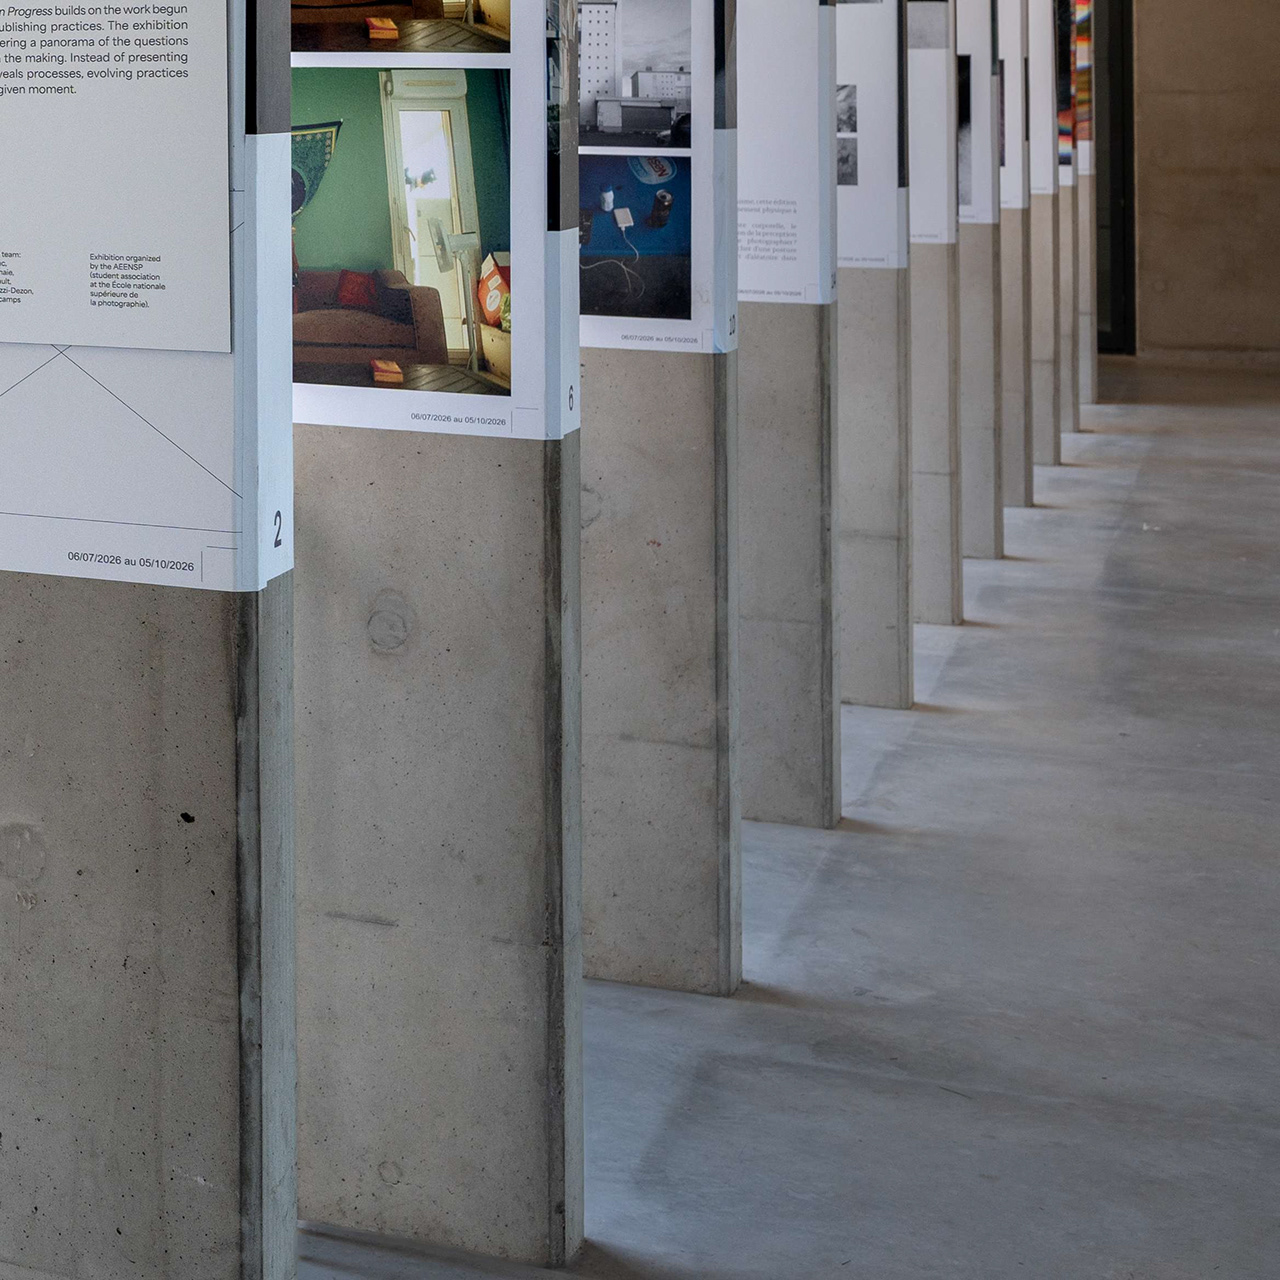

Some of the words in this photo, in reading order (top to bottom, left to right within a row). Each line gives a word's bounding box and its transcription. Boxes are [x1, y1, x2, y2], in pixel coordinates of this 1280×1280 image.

[567, 384, 575, 412] 6
[410, 412, 452, 423] 06/07/2026
[453, 416, 463, 424] au
[464, 416, 507, 427] 05/10/2026
[272, 509, 283, 549] 2
[67, 551, 122, 565] 06/07/2026
[124, 558, 137, 567] au
[138, 557, 195, 572] 05/10/2026
